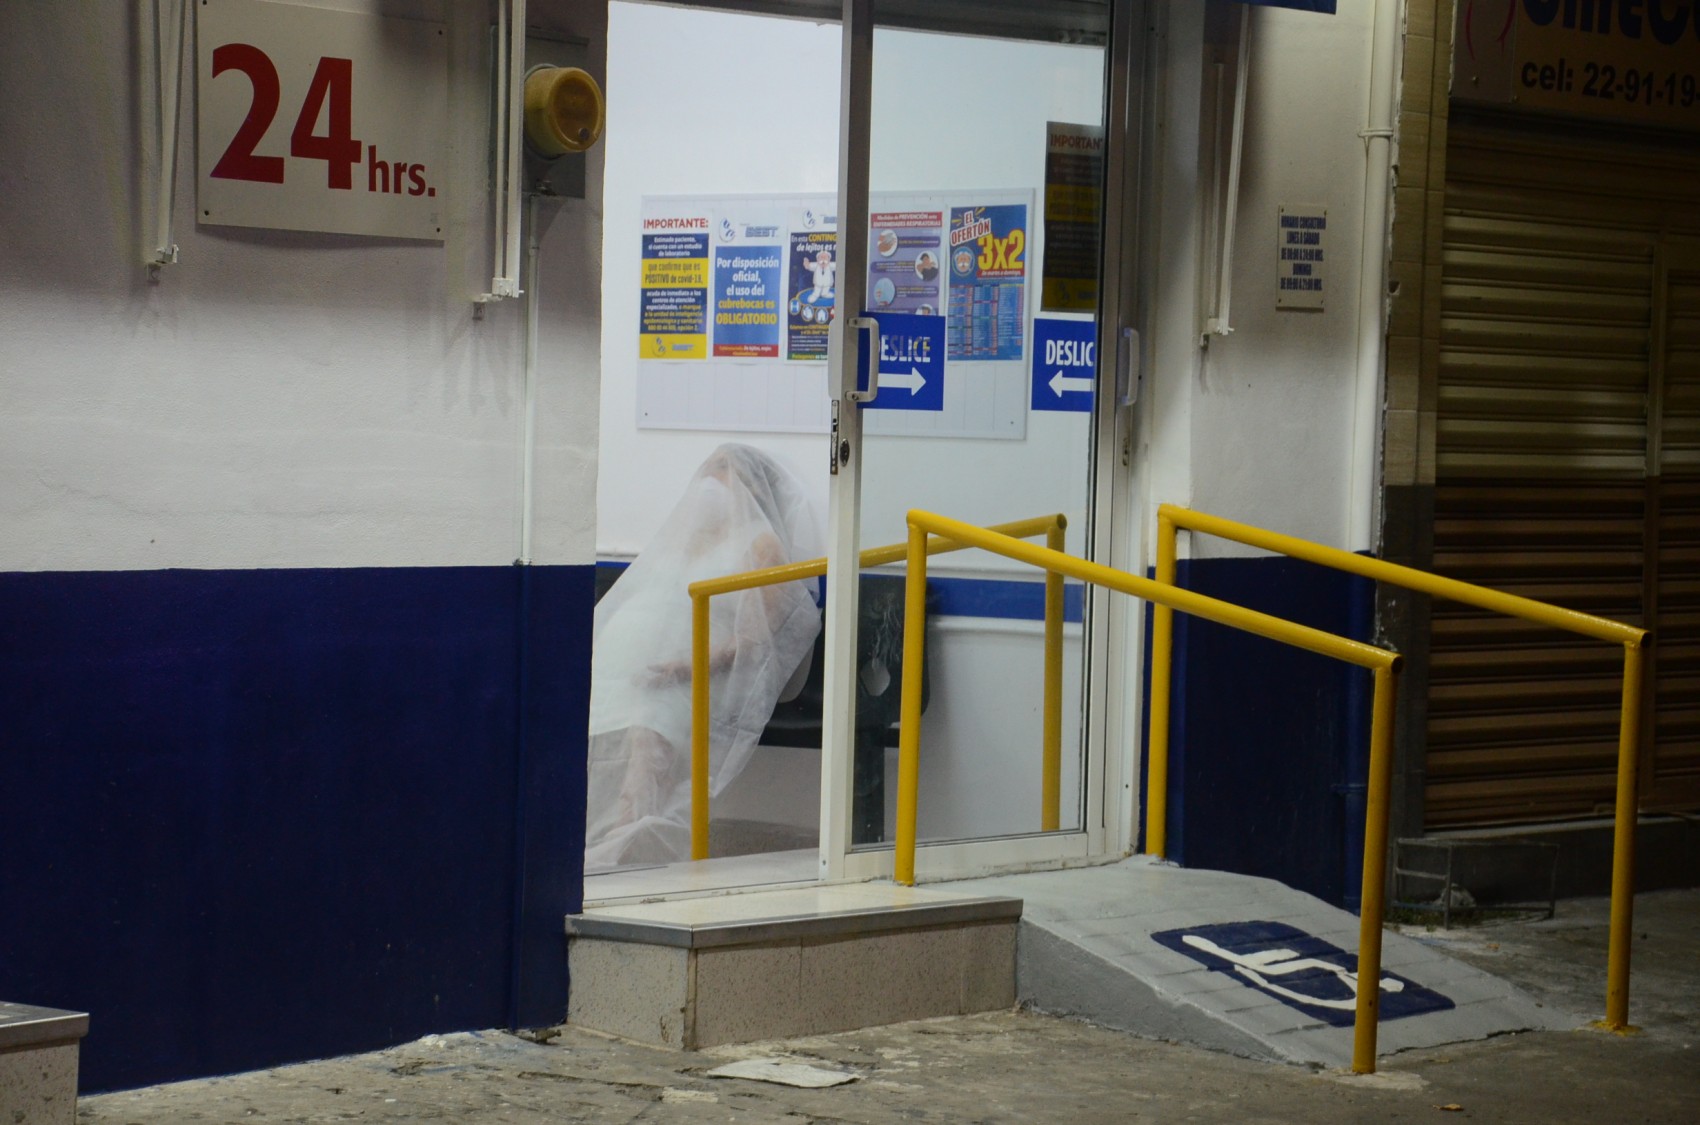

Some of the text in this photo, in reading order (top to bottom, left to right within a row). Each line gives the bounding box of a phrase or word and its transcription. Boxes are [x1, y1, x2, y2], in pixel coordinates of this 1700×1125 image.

[1521, 58, 1574, 92] cel:
[210, 43, 436, 197] 24 hrs.
[1050, 133, 1103, 151] IMPORTAN
[643, 217, 709, 229] IMPORTANTE:
[964, 212, 973, 225] EL
[951, 219, 990, 245] OFERTÓN
[977, 229, 1024, 270] 3x2
[717, 256, 780, 271] Por disposición
[645, 274, 669, 283] POSITIVO
[732, 270, 761, 284] oficial,
[726, 284, 765, 296] el uso del
[718, 298, 776, 309] cubrebocas es
[716, 313, 778, 325] OBLIGATORIO
[879, 335, 931, 363] ESLICE
